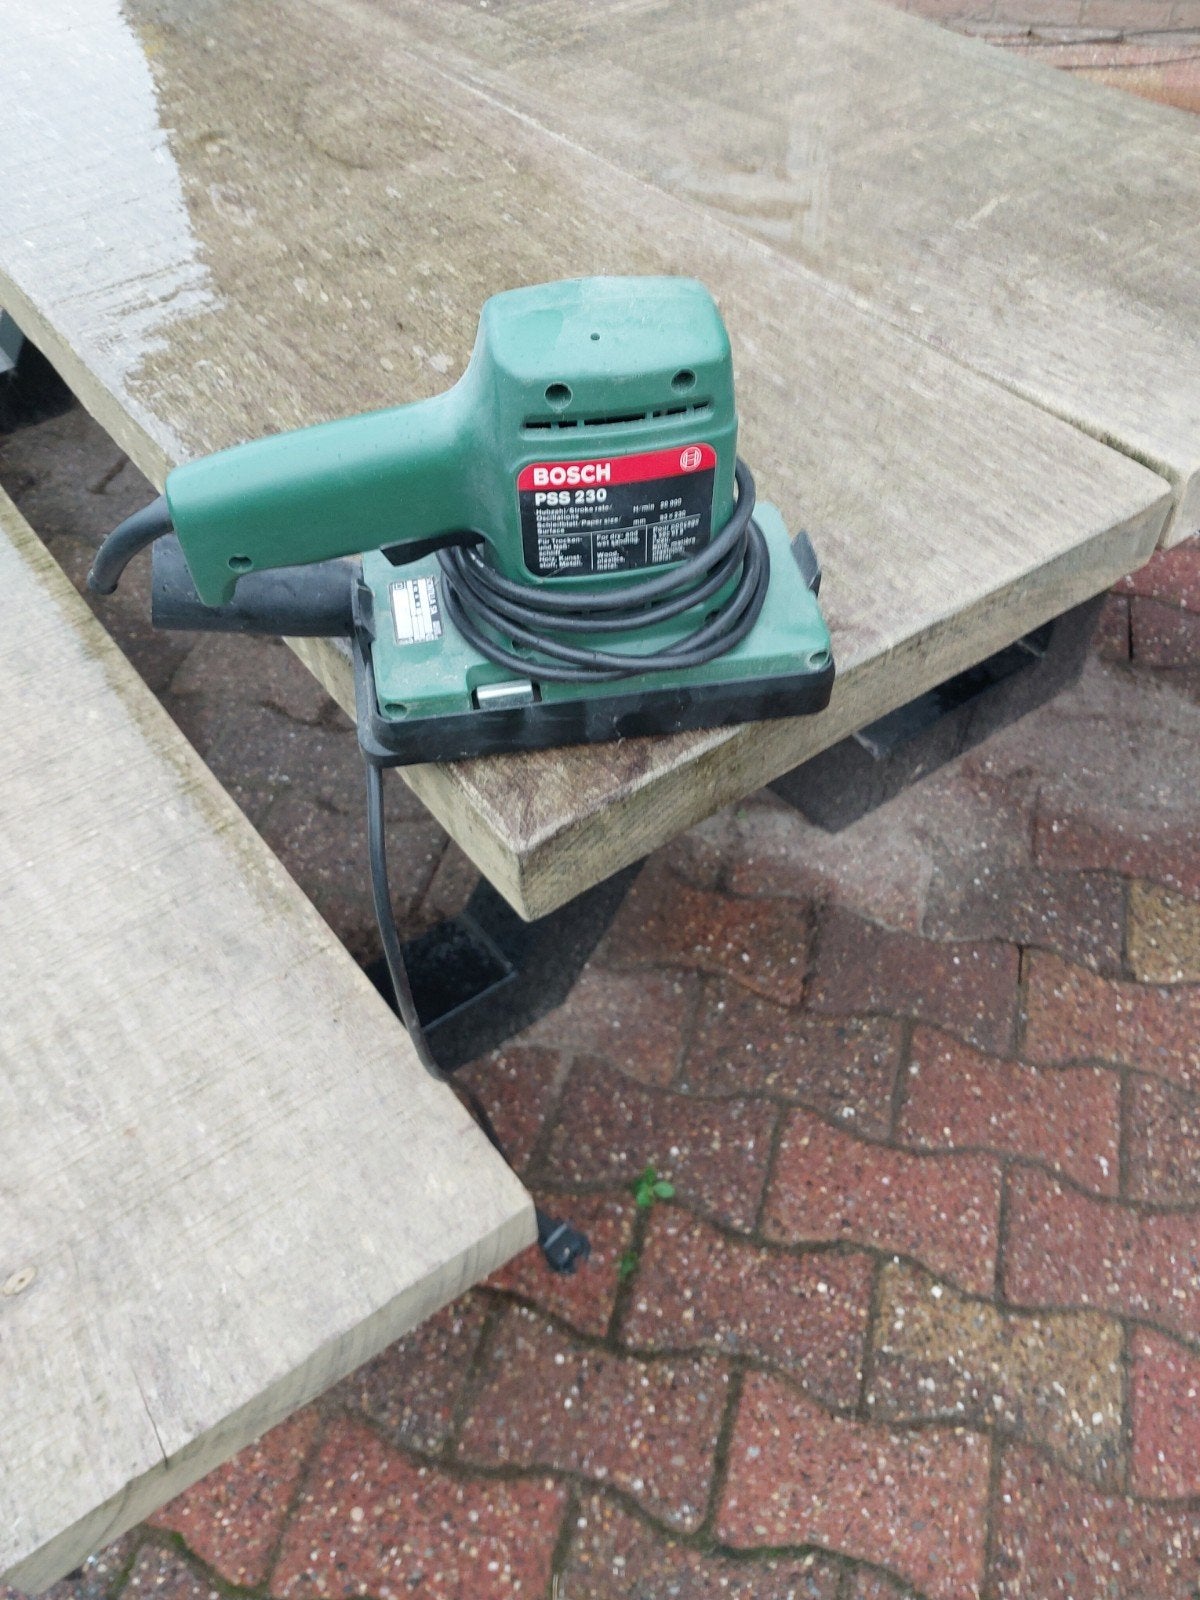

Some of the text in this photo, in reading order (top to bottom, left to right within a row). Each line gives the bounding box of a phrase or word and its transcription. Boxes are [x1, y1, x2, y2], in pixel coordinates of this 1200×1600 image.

[533, 463, 611, 486] BOSCH
[535, 488, 607, 506] PSS 230
